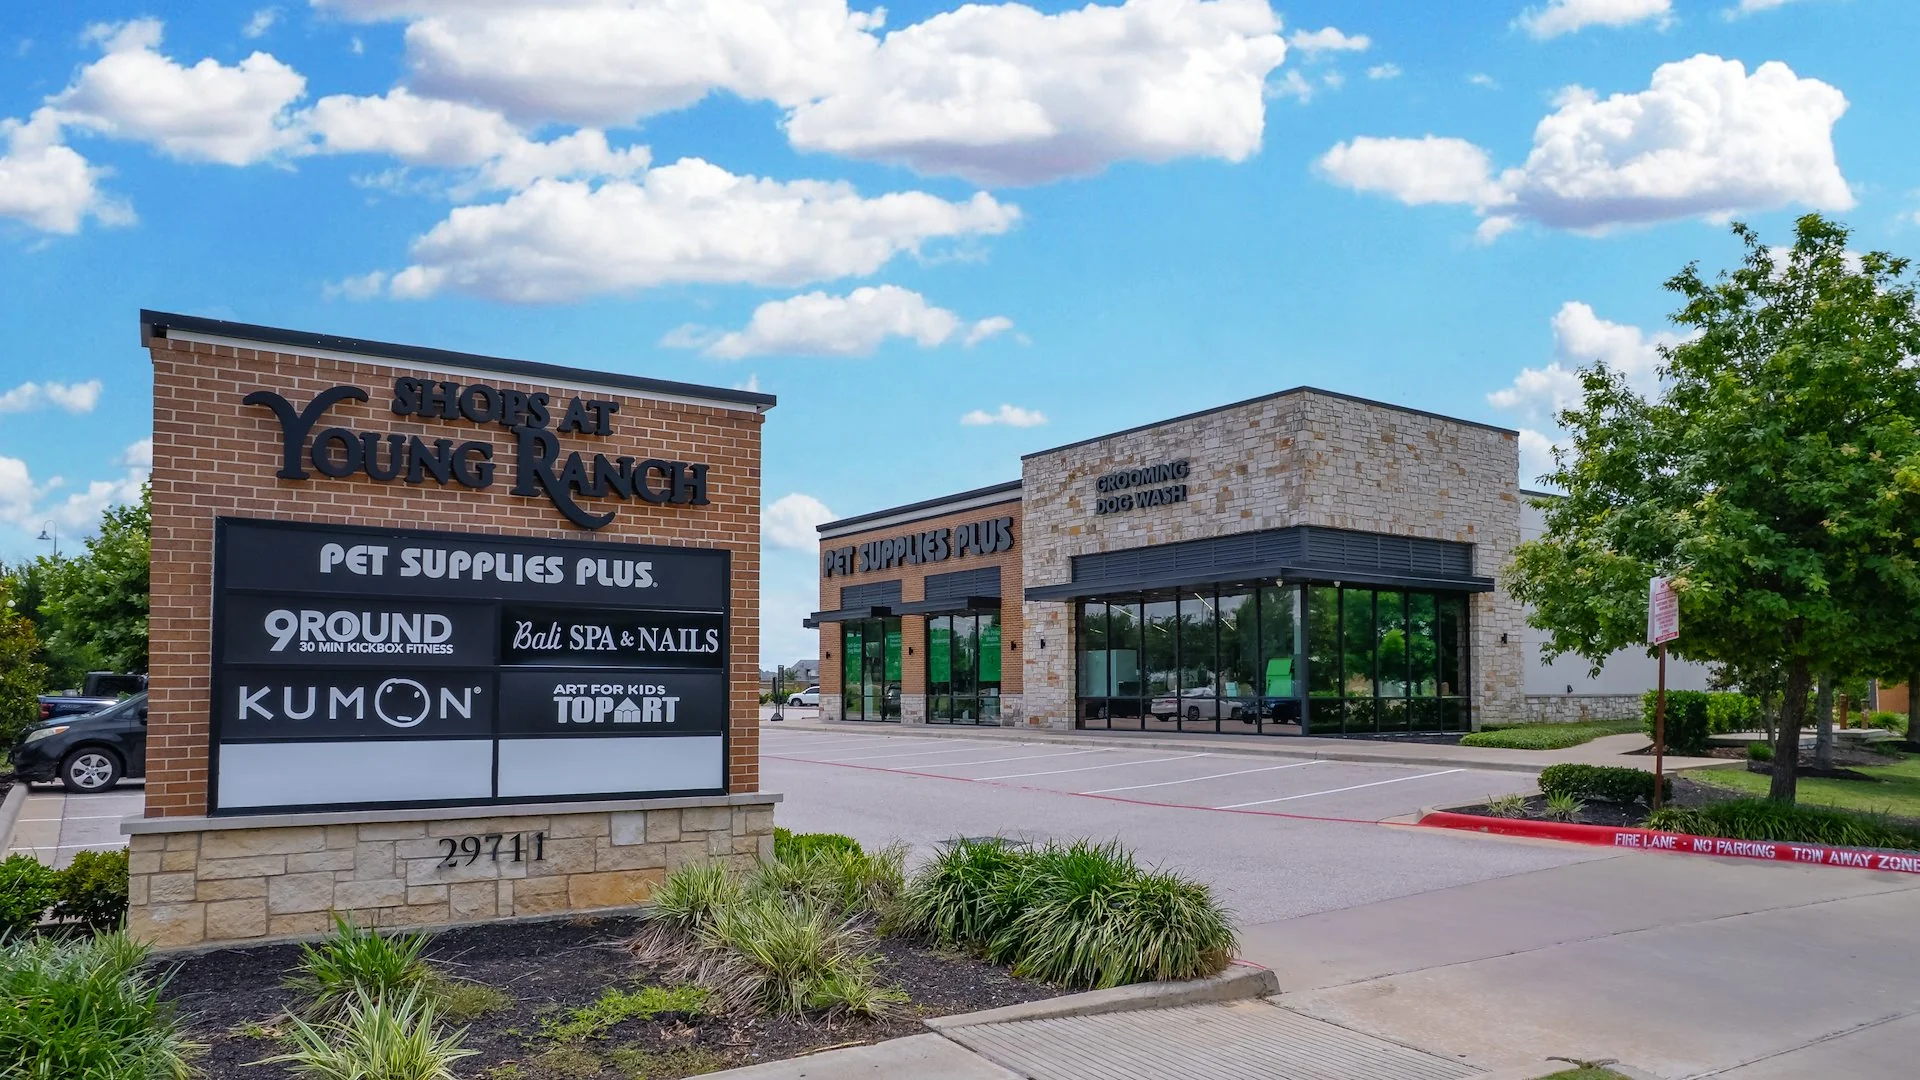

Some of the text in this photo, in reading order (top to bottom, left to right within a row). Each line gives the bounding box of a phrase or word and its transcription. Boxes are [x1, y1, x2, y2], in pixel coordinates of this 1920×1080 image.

[392, 376, 619, 437] SHOPS AT
[243, 386, 711, 529] YOUNG RANCH
[1096, 459, 1190, 493] GROOMING
[1096, 484, 1188, 515] DOG WASH
[319, 542, 653, 588] PET SUPPLIES PLUS
[824, 516, 1013, 578] PET SUPPLIES PLUS
[264, 609, 453, 652] 9ROUND
[299, 641, 454, 655] 30 MIN KICKBOX FITNESS
[512, 620, 719, 653] Bali SPA & NAILS
[553, 684, 666, 695] ART FOR KIDS
[436, 831, 547, 869] 29711
[1615, 832, 1641, 848] FIRE
[1644, 834, 1677, 849] LANE
[1693, 838, 1712, 852] NO
[1716, 840, 1776, 859] PARKING
[1792, 847, 1824, 863] TOW
[1828, 850, 1873, 867] AWAY
[1878, 855, 1920, 873] ZONE
